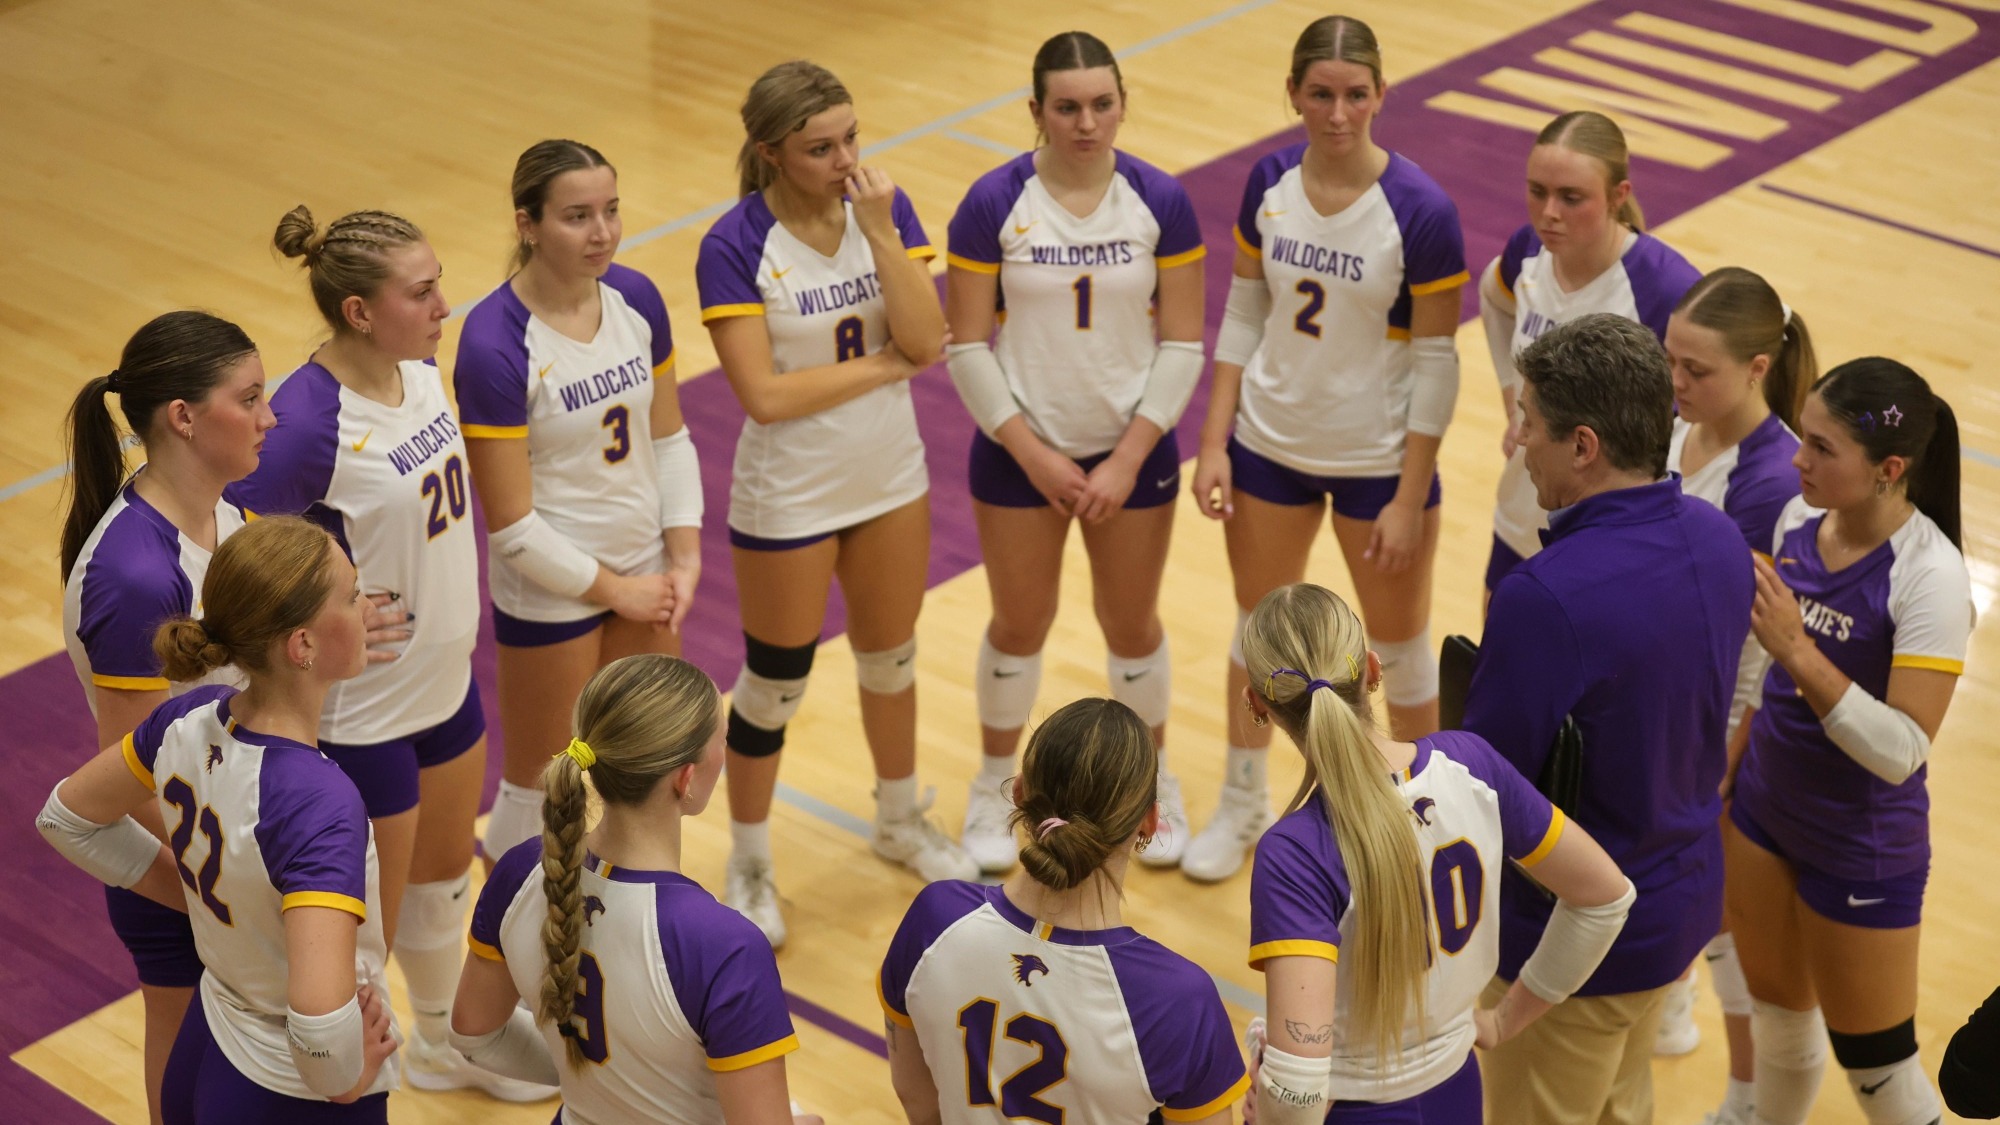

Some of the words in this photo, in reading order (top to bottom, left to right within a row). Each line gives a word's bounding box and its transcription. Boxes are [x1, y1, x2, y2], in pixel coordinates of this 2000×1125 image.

[1031, 240, 1132, 265] WILDCATS
[1271, 235, 1364, 282] WILDCATS
[1072, 274, 1093, 330] 1
[1294, 278, 1325, 340] 2
[834, 314, 866, 363] 8
[559, 356, 648, 412] WILDCATS
[387, 411, 458, 476] WILDCATS
[601, 403, 631, 464] 3
[420, 452, 467, 543] 20
[163, 772, 235, 928] 22
[956, 996, 1070, 1125] 12
